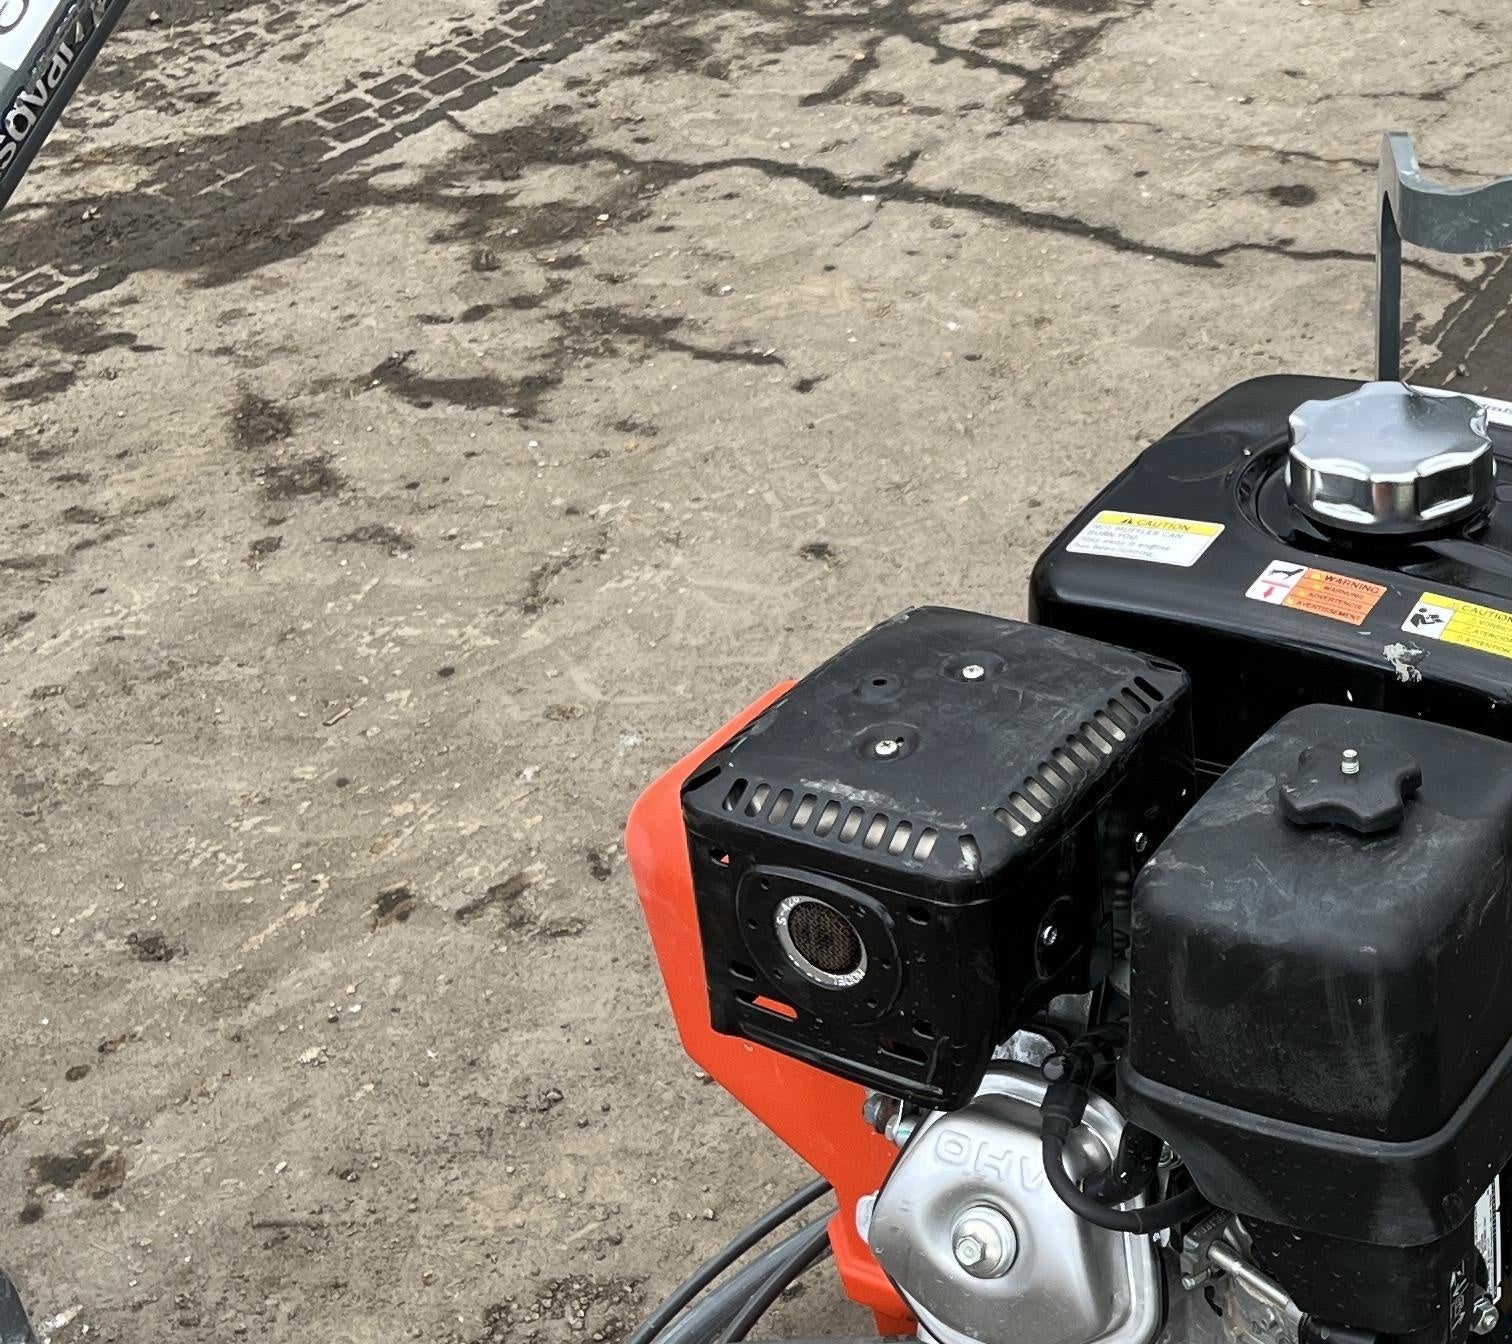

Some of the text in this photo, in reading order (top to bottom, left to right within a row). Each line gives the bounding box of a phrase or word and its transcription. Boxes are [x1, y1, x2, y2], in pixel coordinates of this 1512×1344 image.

[1136, 517, 1191, 532] CAUTION
[1323, 573, 1381, 594] WARNING
[1295, 600, 1362, 622] AVERTISSEMENT
[1464, 637, 1512, 654] ATTENTION
